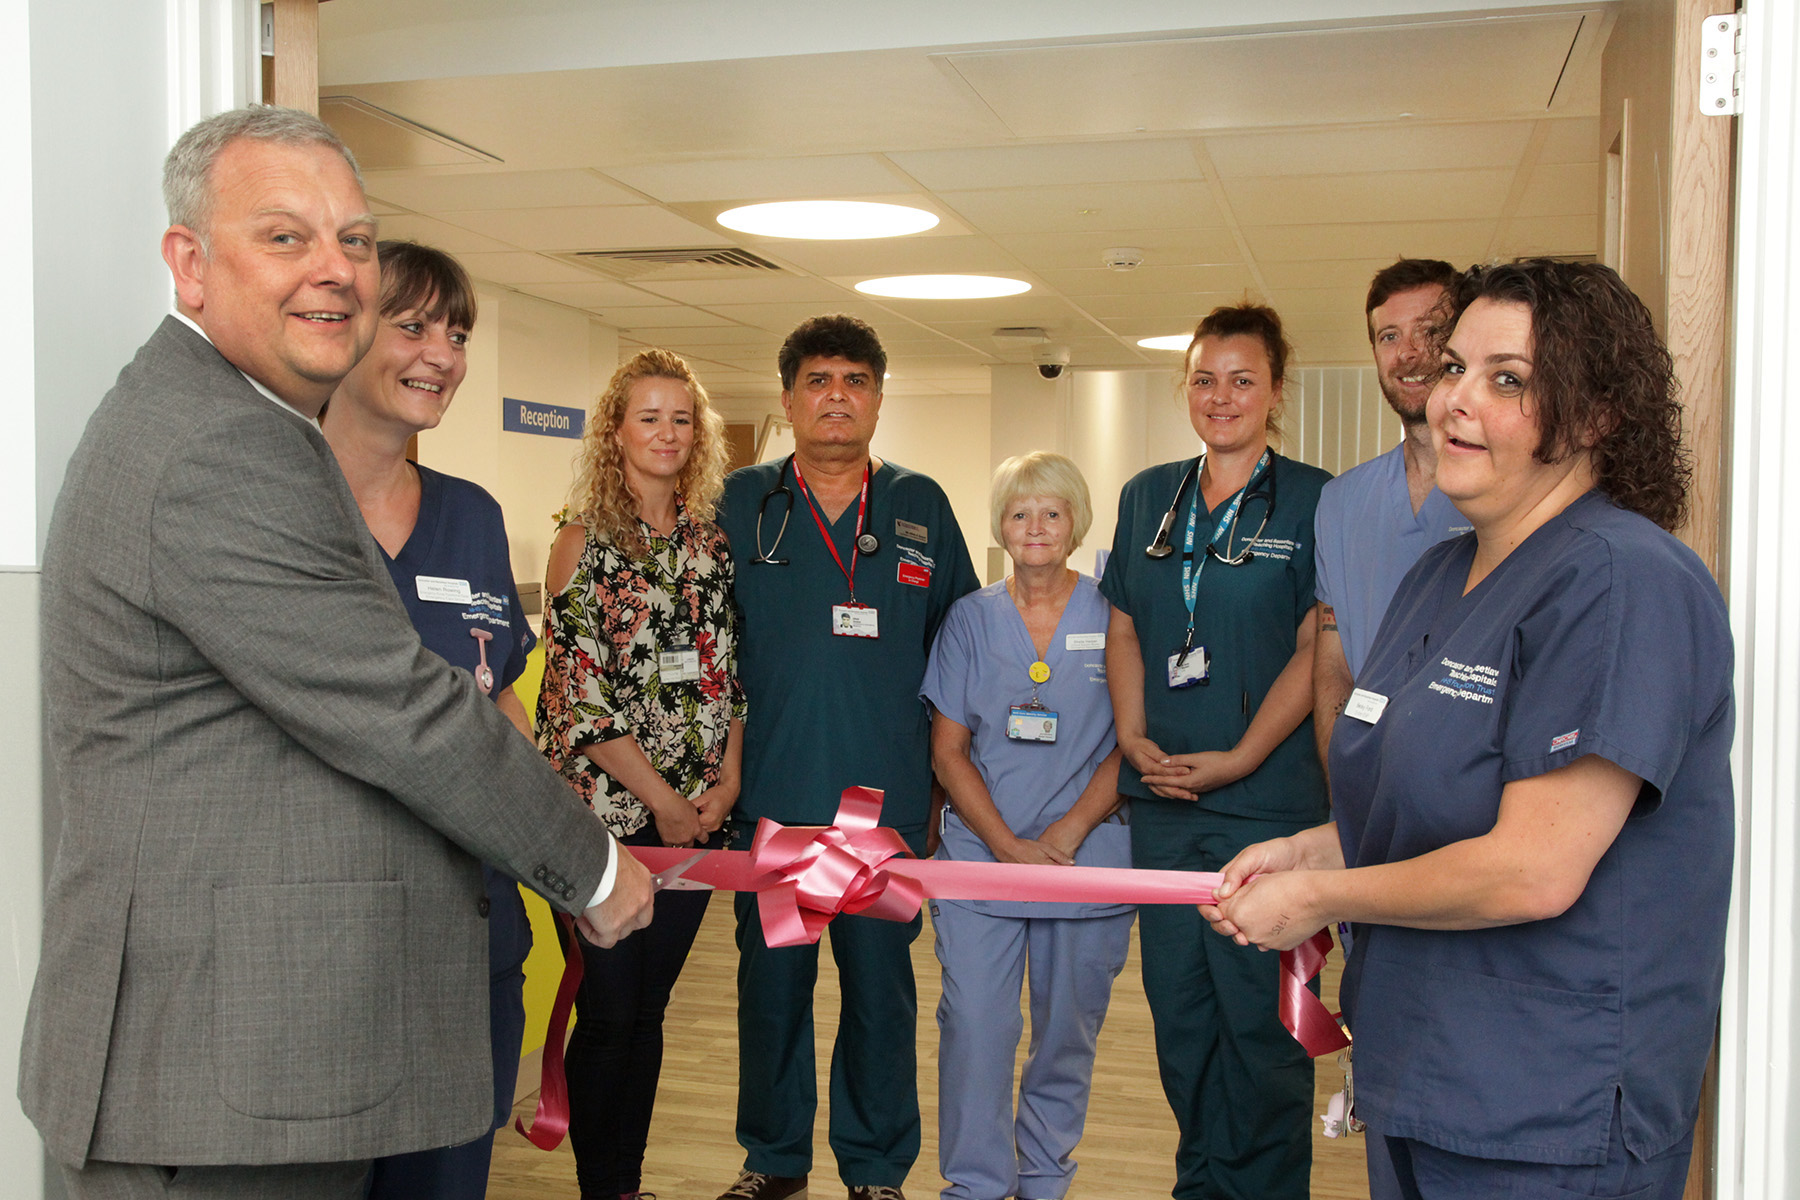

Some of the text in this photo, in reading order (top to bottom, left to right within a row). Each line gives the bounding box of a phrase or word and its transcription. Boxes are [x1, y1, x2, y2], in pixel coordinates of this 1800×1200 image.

[520, 405, 570, 432] Reception
[1189, 512, 1197, 528] NHS
[1223, 508, 1235, 524] NHS
[1186, 530, 1194, 545] NHS
[1184, 566, 1192, 579] NHS
[1184, 584, 1192, 600] NHS
[1476, 683, 1496, 696] Trust
